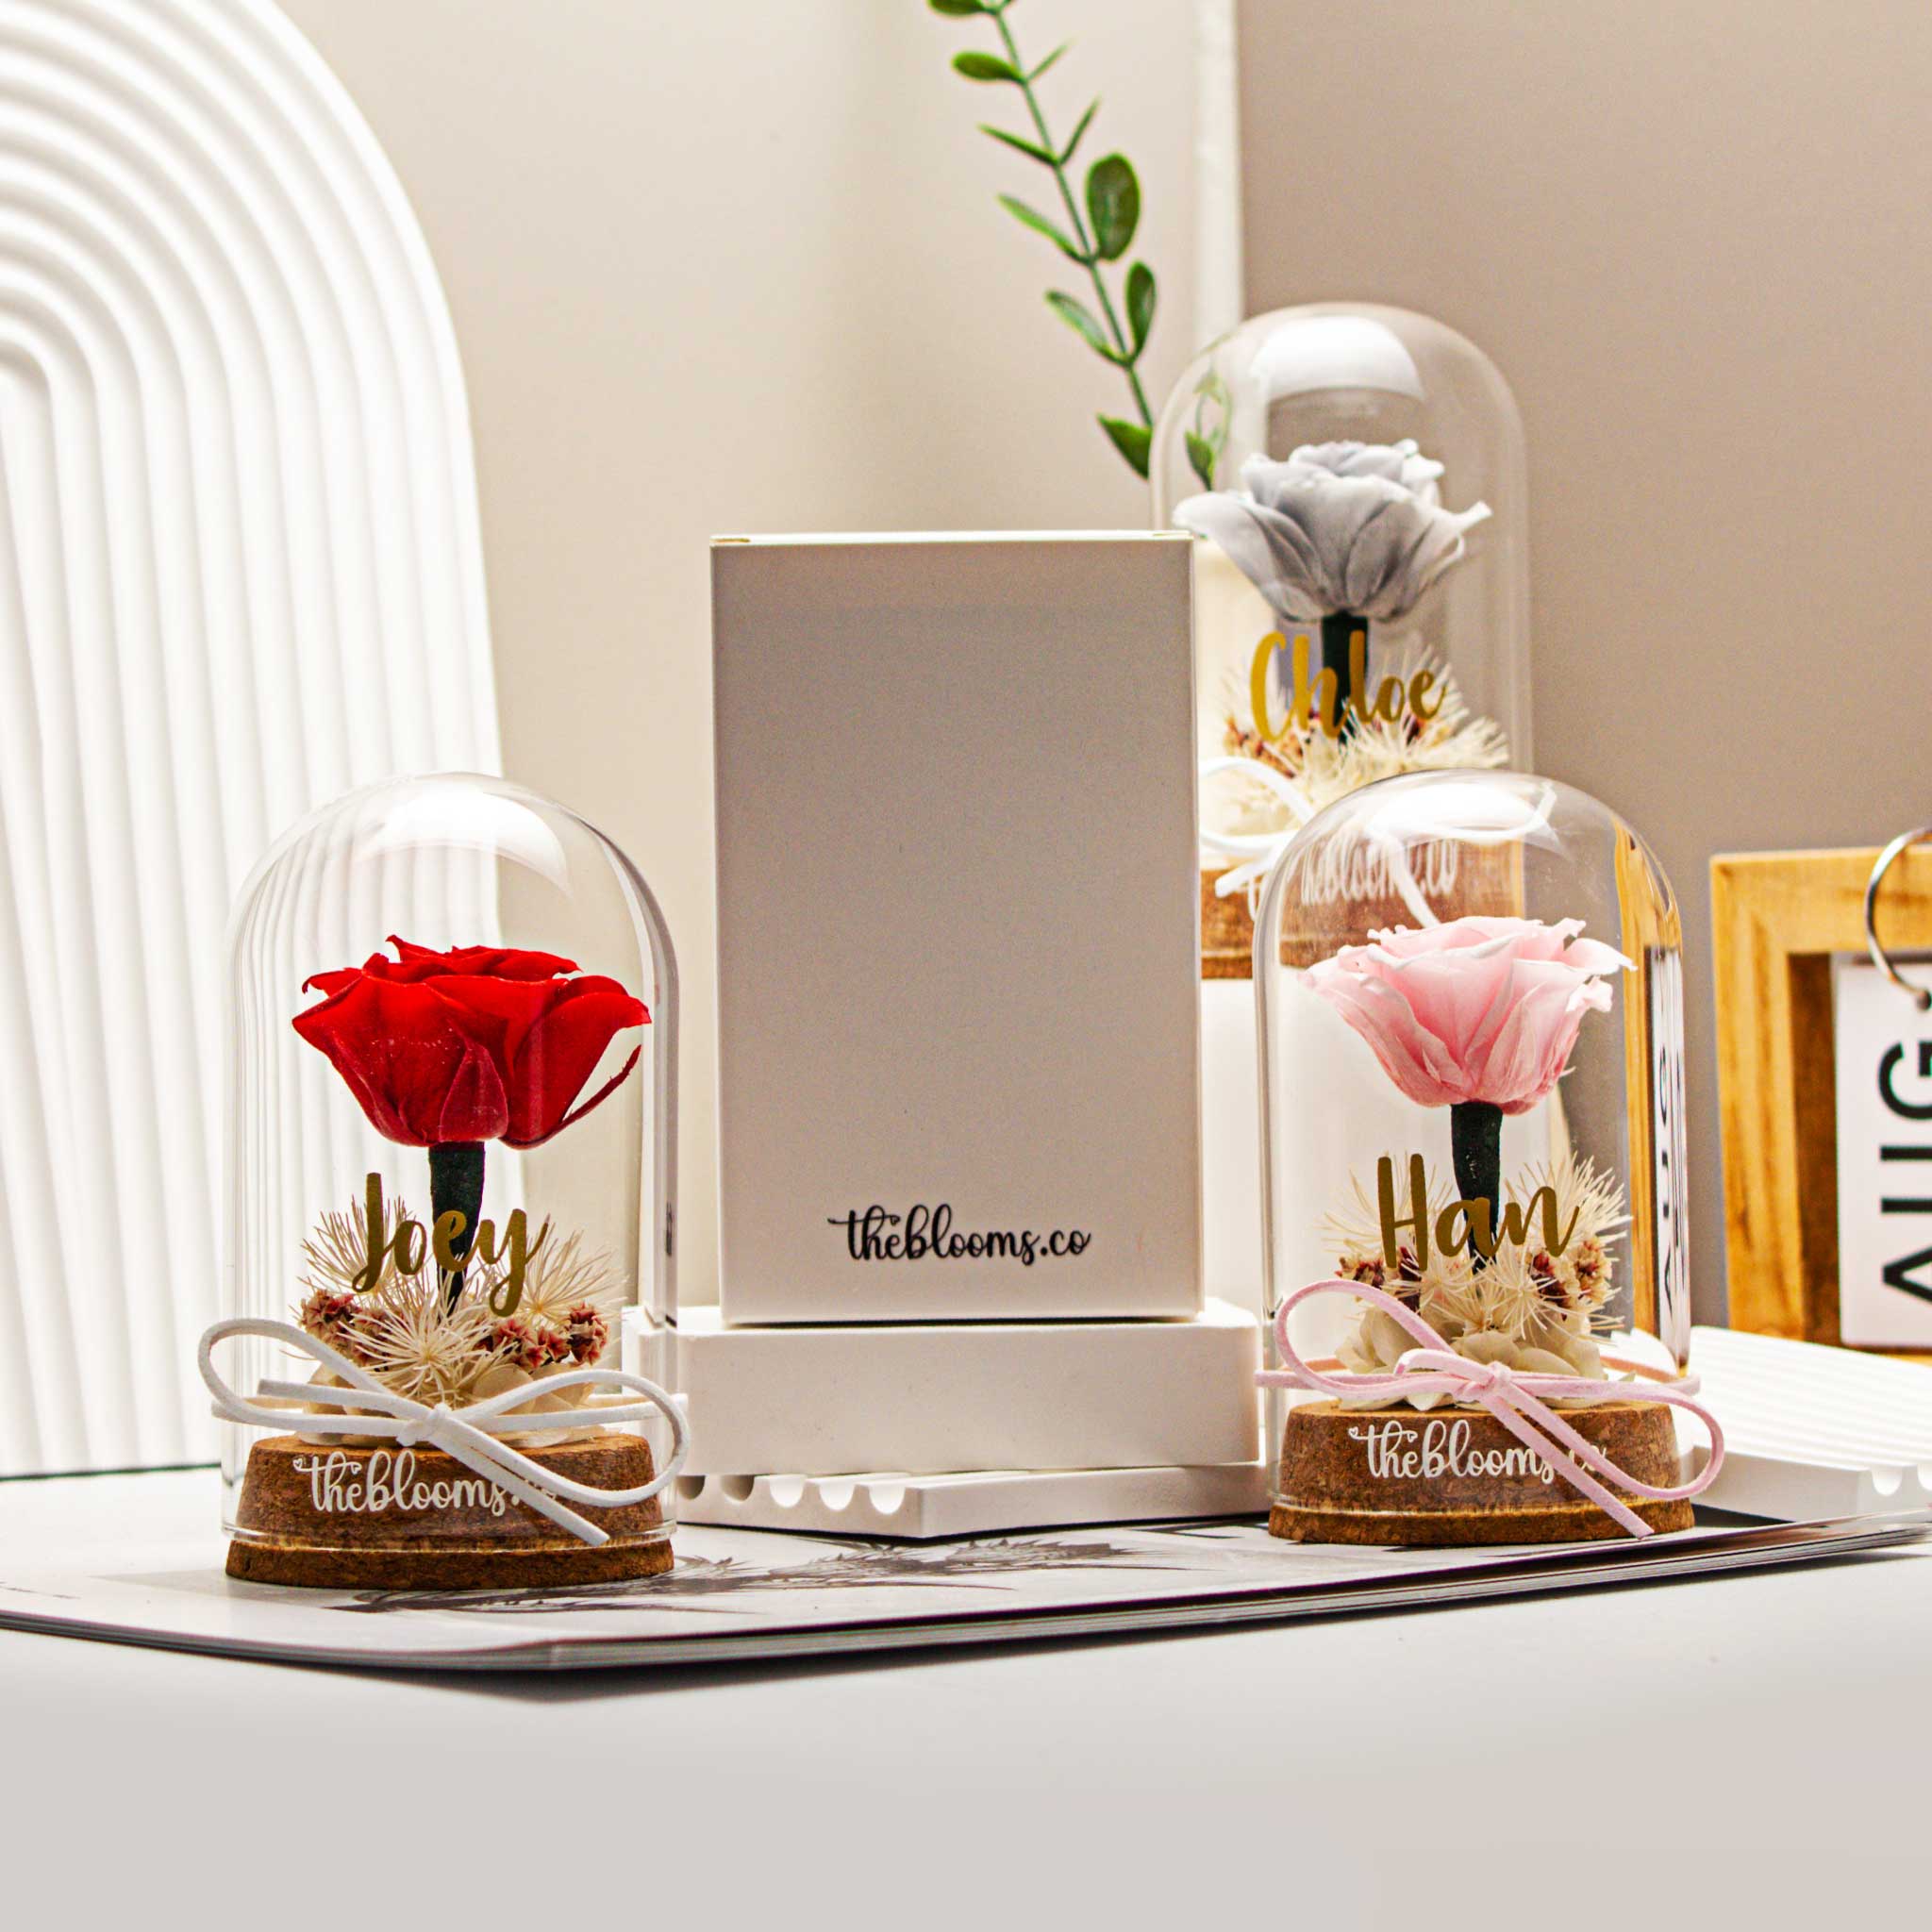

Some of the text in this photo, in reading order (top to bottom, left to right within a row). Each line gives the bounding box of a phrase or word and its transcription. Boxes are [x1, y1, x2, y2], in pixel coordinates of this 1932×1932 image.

[1249, 629, 1447, 741] Chloe
[352, 1172, 549, 1317] Joey
[1377, 1153, 1580, 1272] Han
